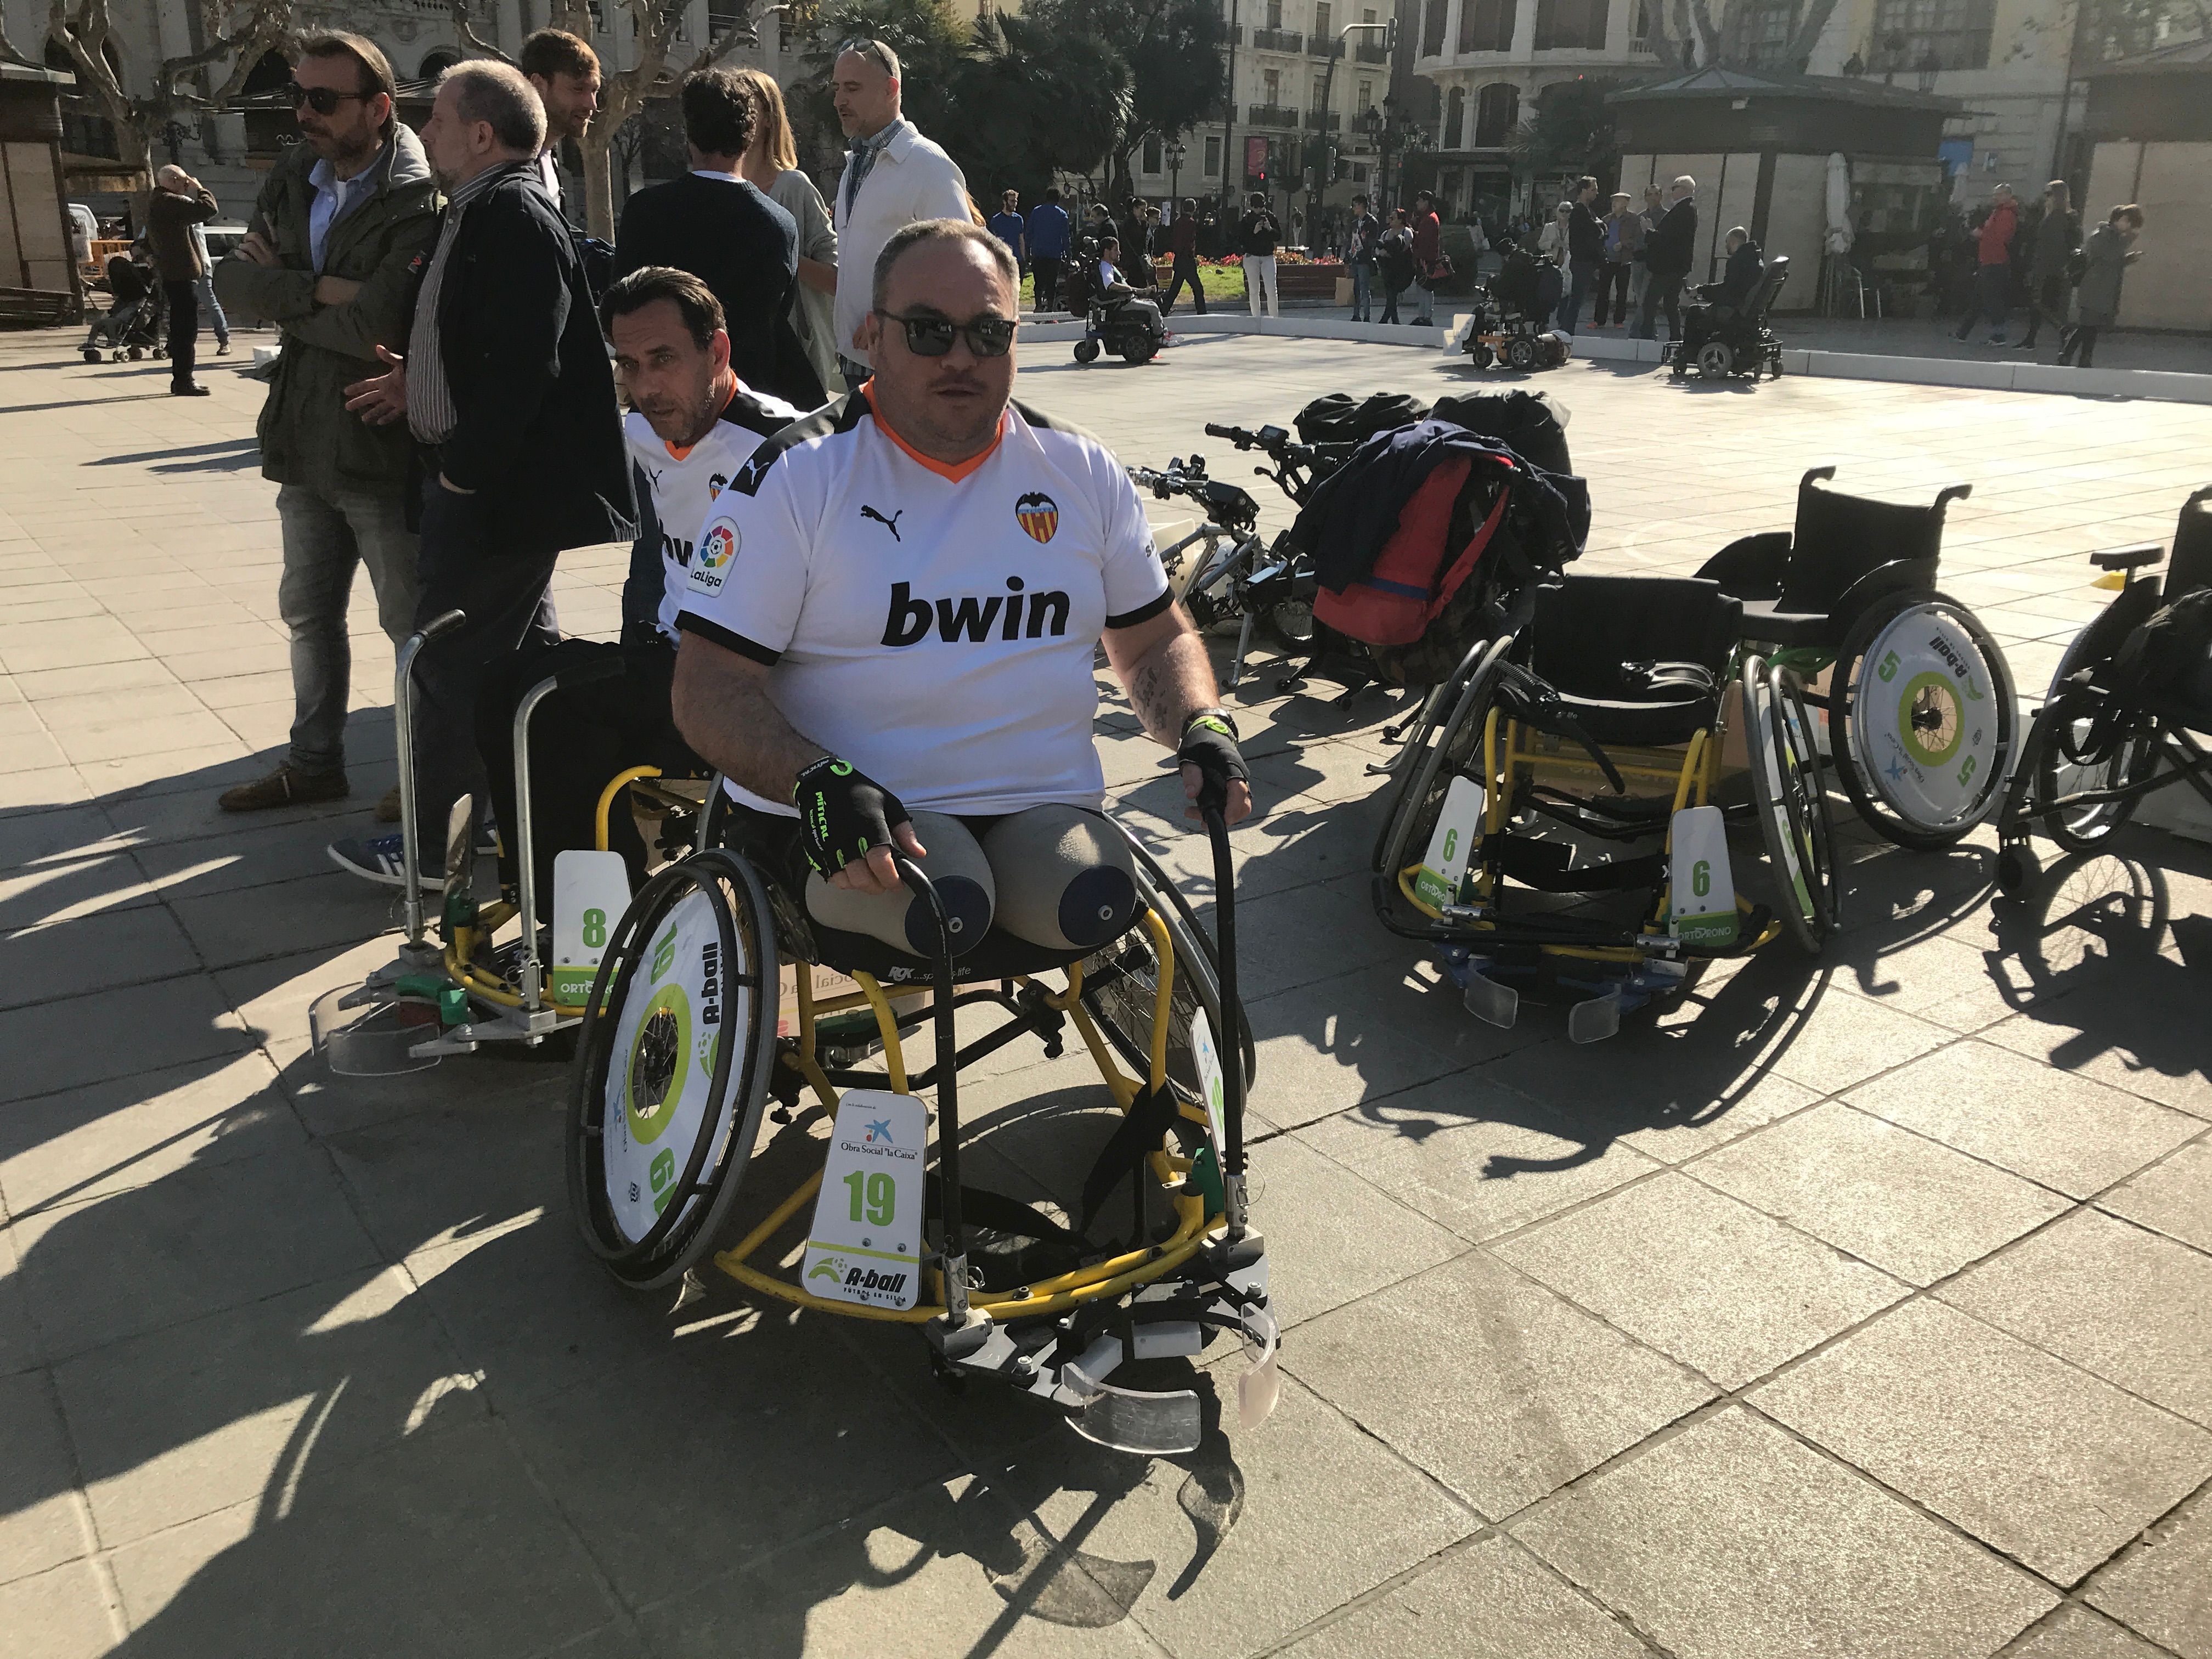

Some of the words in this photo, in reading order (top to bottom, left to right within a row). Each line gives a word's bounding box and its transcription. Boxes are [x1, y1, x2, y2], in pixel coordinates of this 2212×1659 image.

[690, 568, 723, 587] LaLiga
[880, 576, 1070, 646] bwin
[1878, 649, 1901, 682] 5
[1443, 828, 1458, 862] 6
[1421, 881, 1446, 902] ORTOPRO
[1693, 860, 1711, 896] 6
[583, 908, 606, 948] 8
[702, 942, 720, 1025] A-ball
[957, 967, 971, 976] life
[841, 1142, 860, 1152] Obra
[862, 1145, 883, 1155] Social
[843, 1170, 895, 1226] 19
[845, 1267, 907, 1293] A-ball
